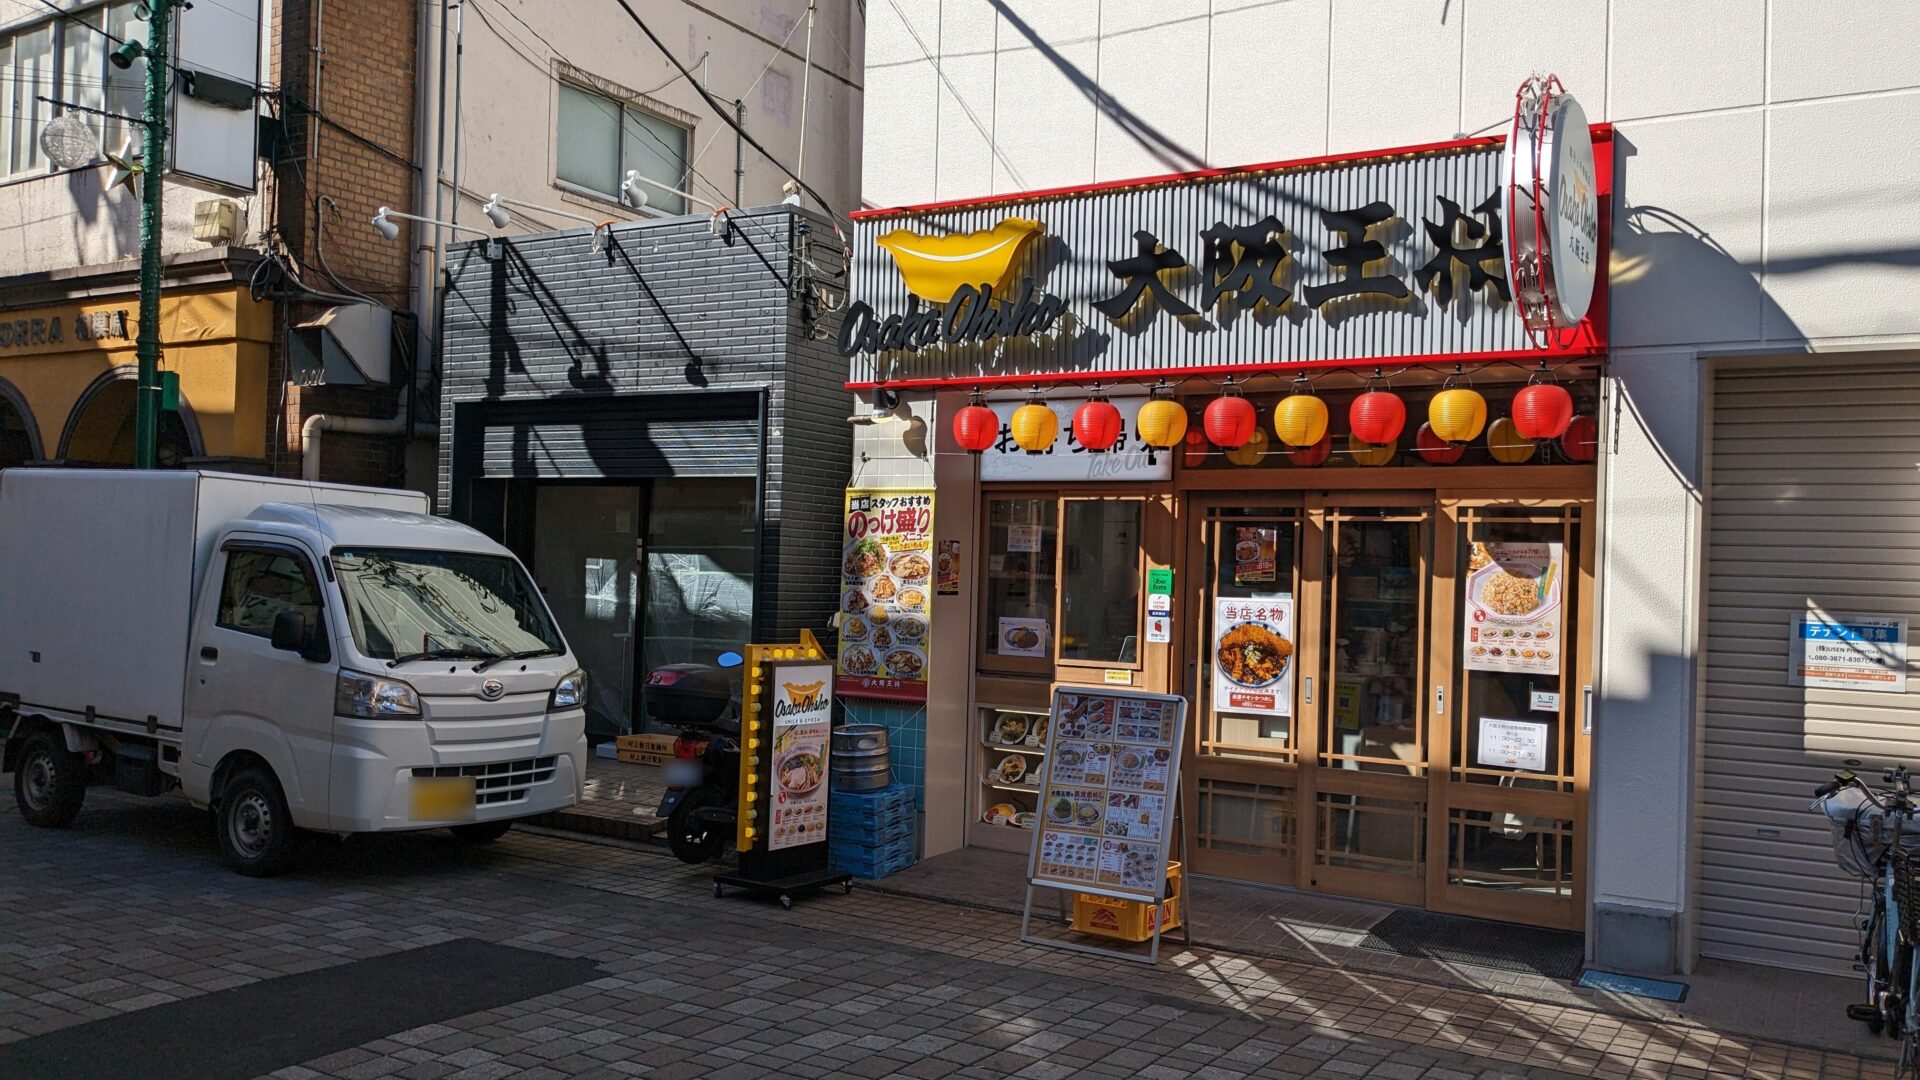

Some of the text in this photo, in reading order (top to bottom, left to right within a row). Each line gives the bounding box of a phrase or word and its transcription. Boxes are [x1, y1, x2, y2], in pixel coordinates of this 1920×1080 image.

[1093, 185, 1511, 316] 大阪王将
[838, 277, 1070, 357] Osaka Ohsho
[1087, 452, 1122, 479] Take
[848, 507, 930, 538] のっけ盛り
[902, 532, 929, 542] メニュー
[1226, 605, 1284, 622] 当店名物
[1809, 625, 1888, 641] テナント募集
[1847, 647, 1880, 655] Properties
[775, 692, 829, 718] Osaka Ohsho
